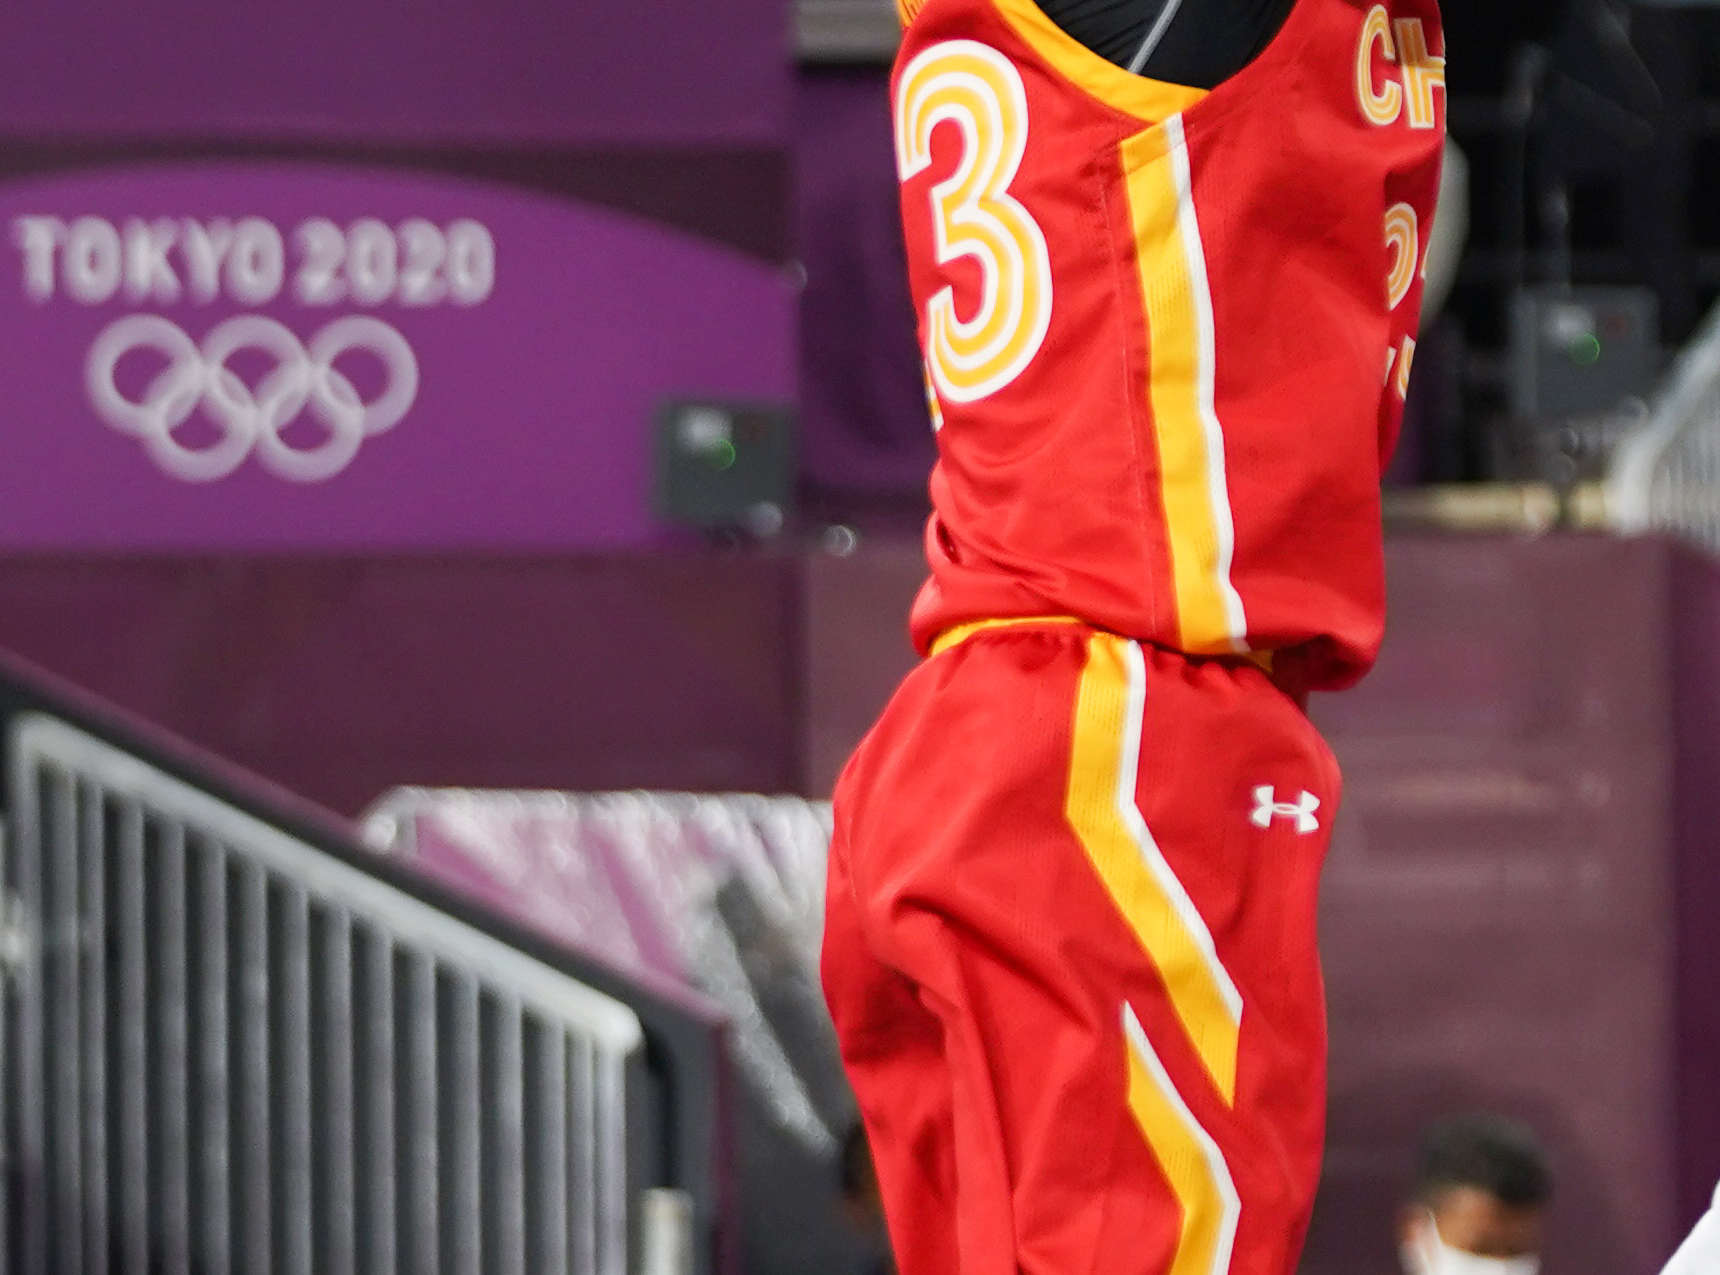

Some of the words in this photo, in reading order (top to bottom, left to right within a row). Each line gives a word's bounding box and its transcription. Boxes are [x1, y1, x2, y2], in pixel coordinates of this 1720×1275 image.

[13, 214, 285, 306] TOKYO
[294, 216, 496, 307] 2020
[900, 39, 1053, 404] 3
